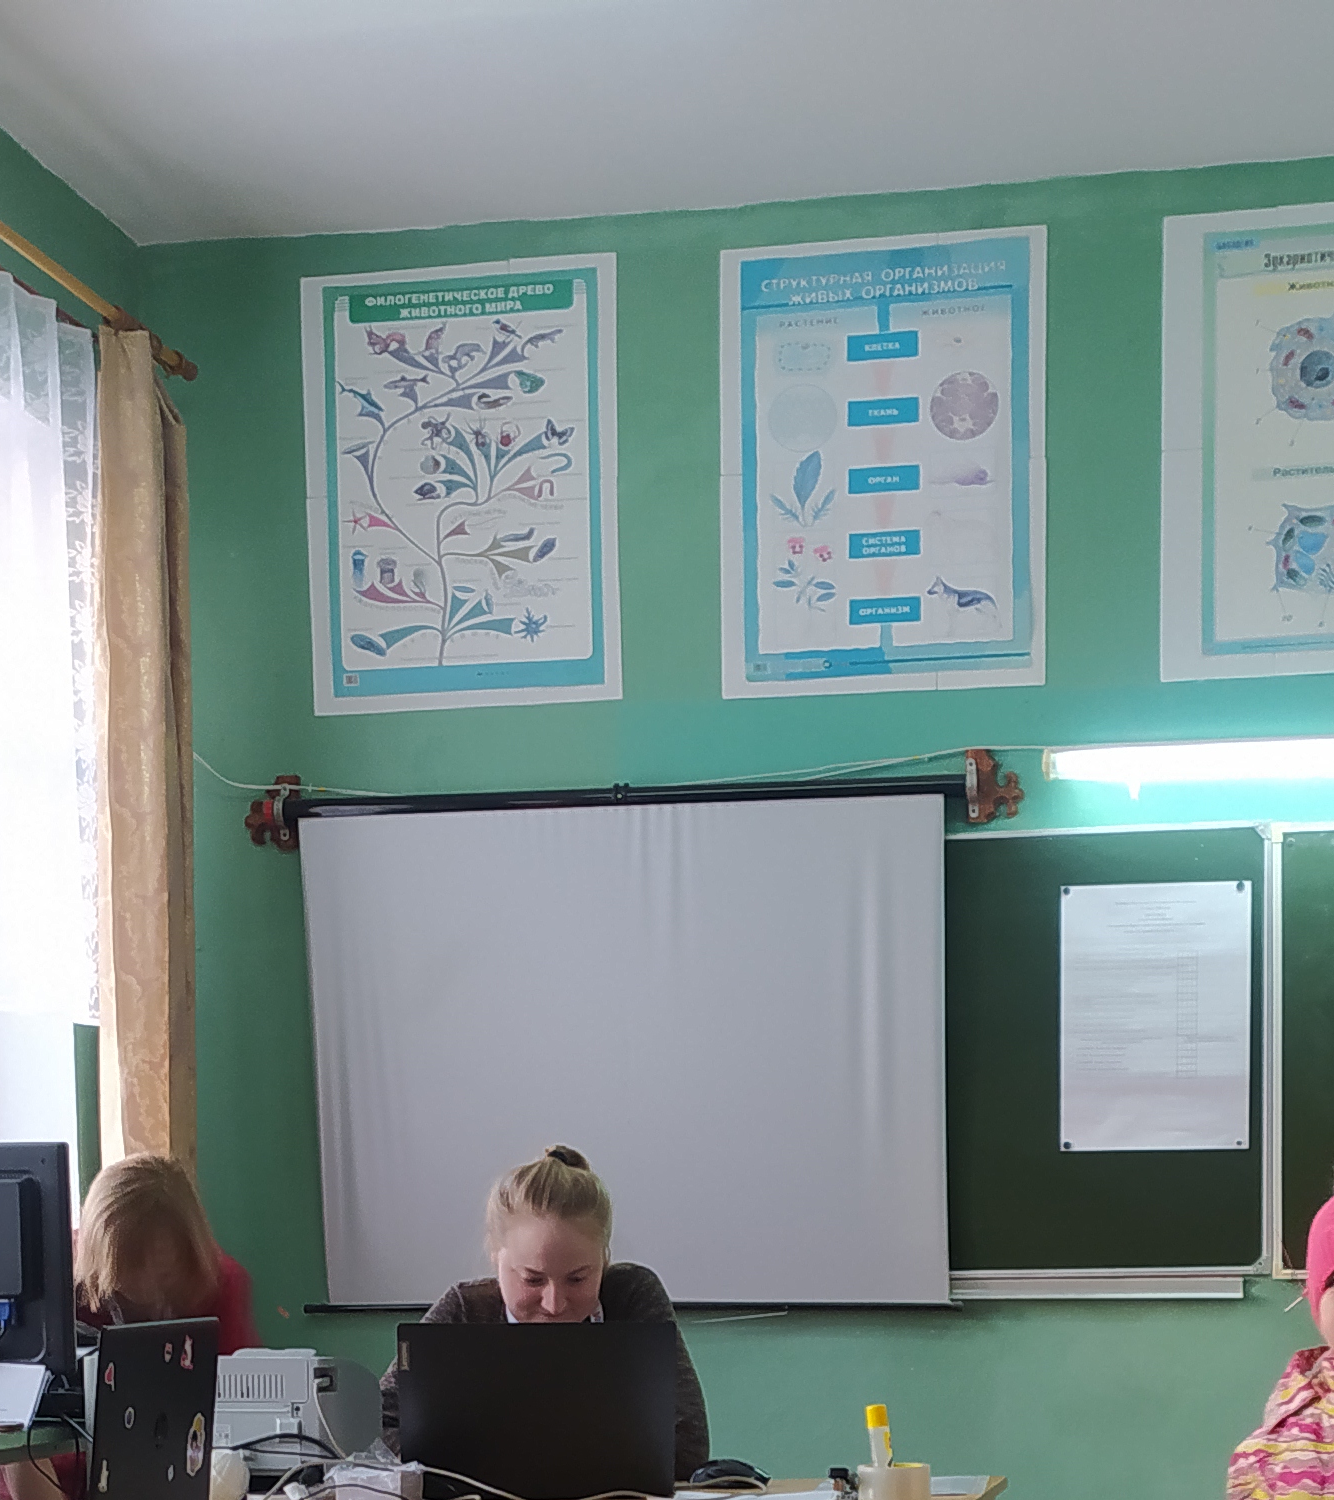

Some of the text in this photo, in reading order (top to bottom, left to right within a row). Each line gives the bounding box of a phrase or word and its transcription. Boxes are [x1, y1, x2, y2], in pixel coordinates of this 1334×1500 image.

[761, 260, 1007, 292] СТРУКТУРНАЯ ОРГАНИЗАЦИЯ
[365, 283, 554, 306] ФИЛОГЕНЕТИЧЕСКОЕ ДРЕВО
[788, 279, 979, 306] ЖИВЫХ ОРГАНИЗМОВ
[399, 300, 523, 319] ЖИВОТНОГО МИРА
[779, 316, 839, 328] РАСТЕНИЕ
[869, 408, 899, 417] ТКАНЬ
[868, 475, 900, 485] ОРГАН
[862, 536, 906, 546] СИСТЕМА
[862, 544, 907, 555] ОРГАНОВ
[858, 605, 911, 616] ОРГАНИЗМ
